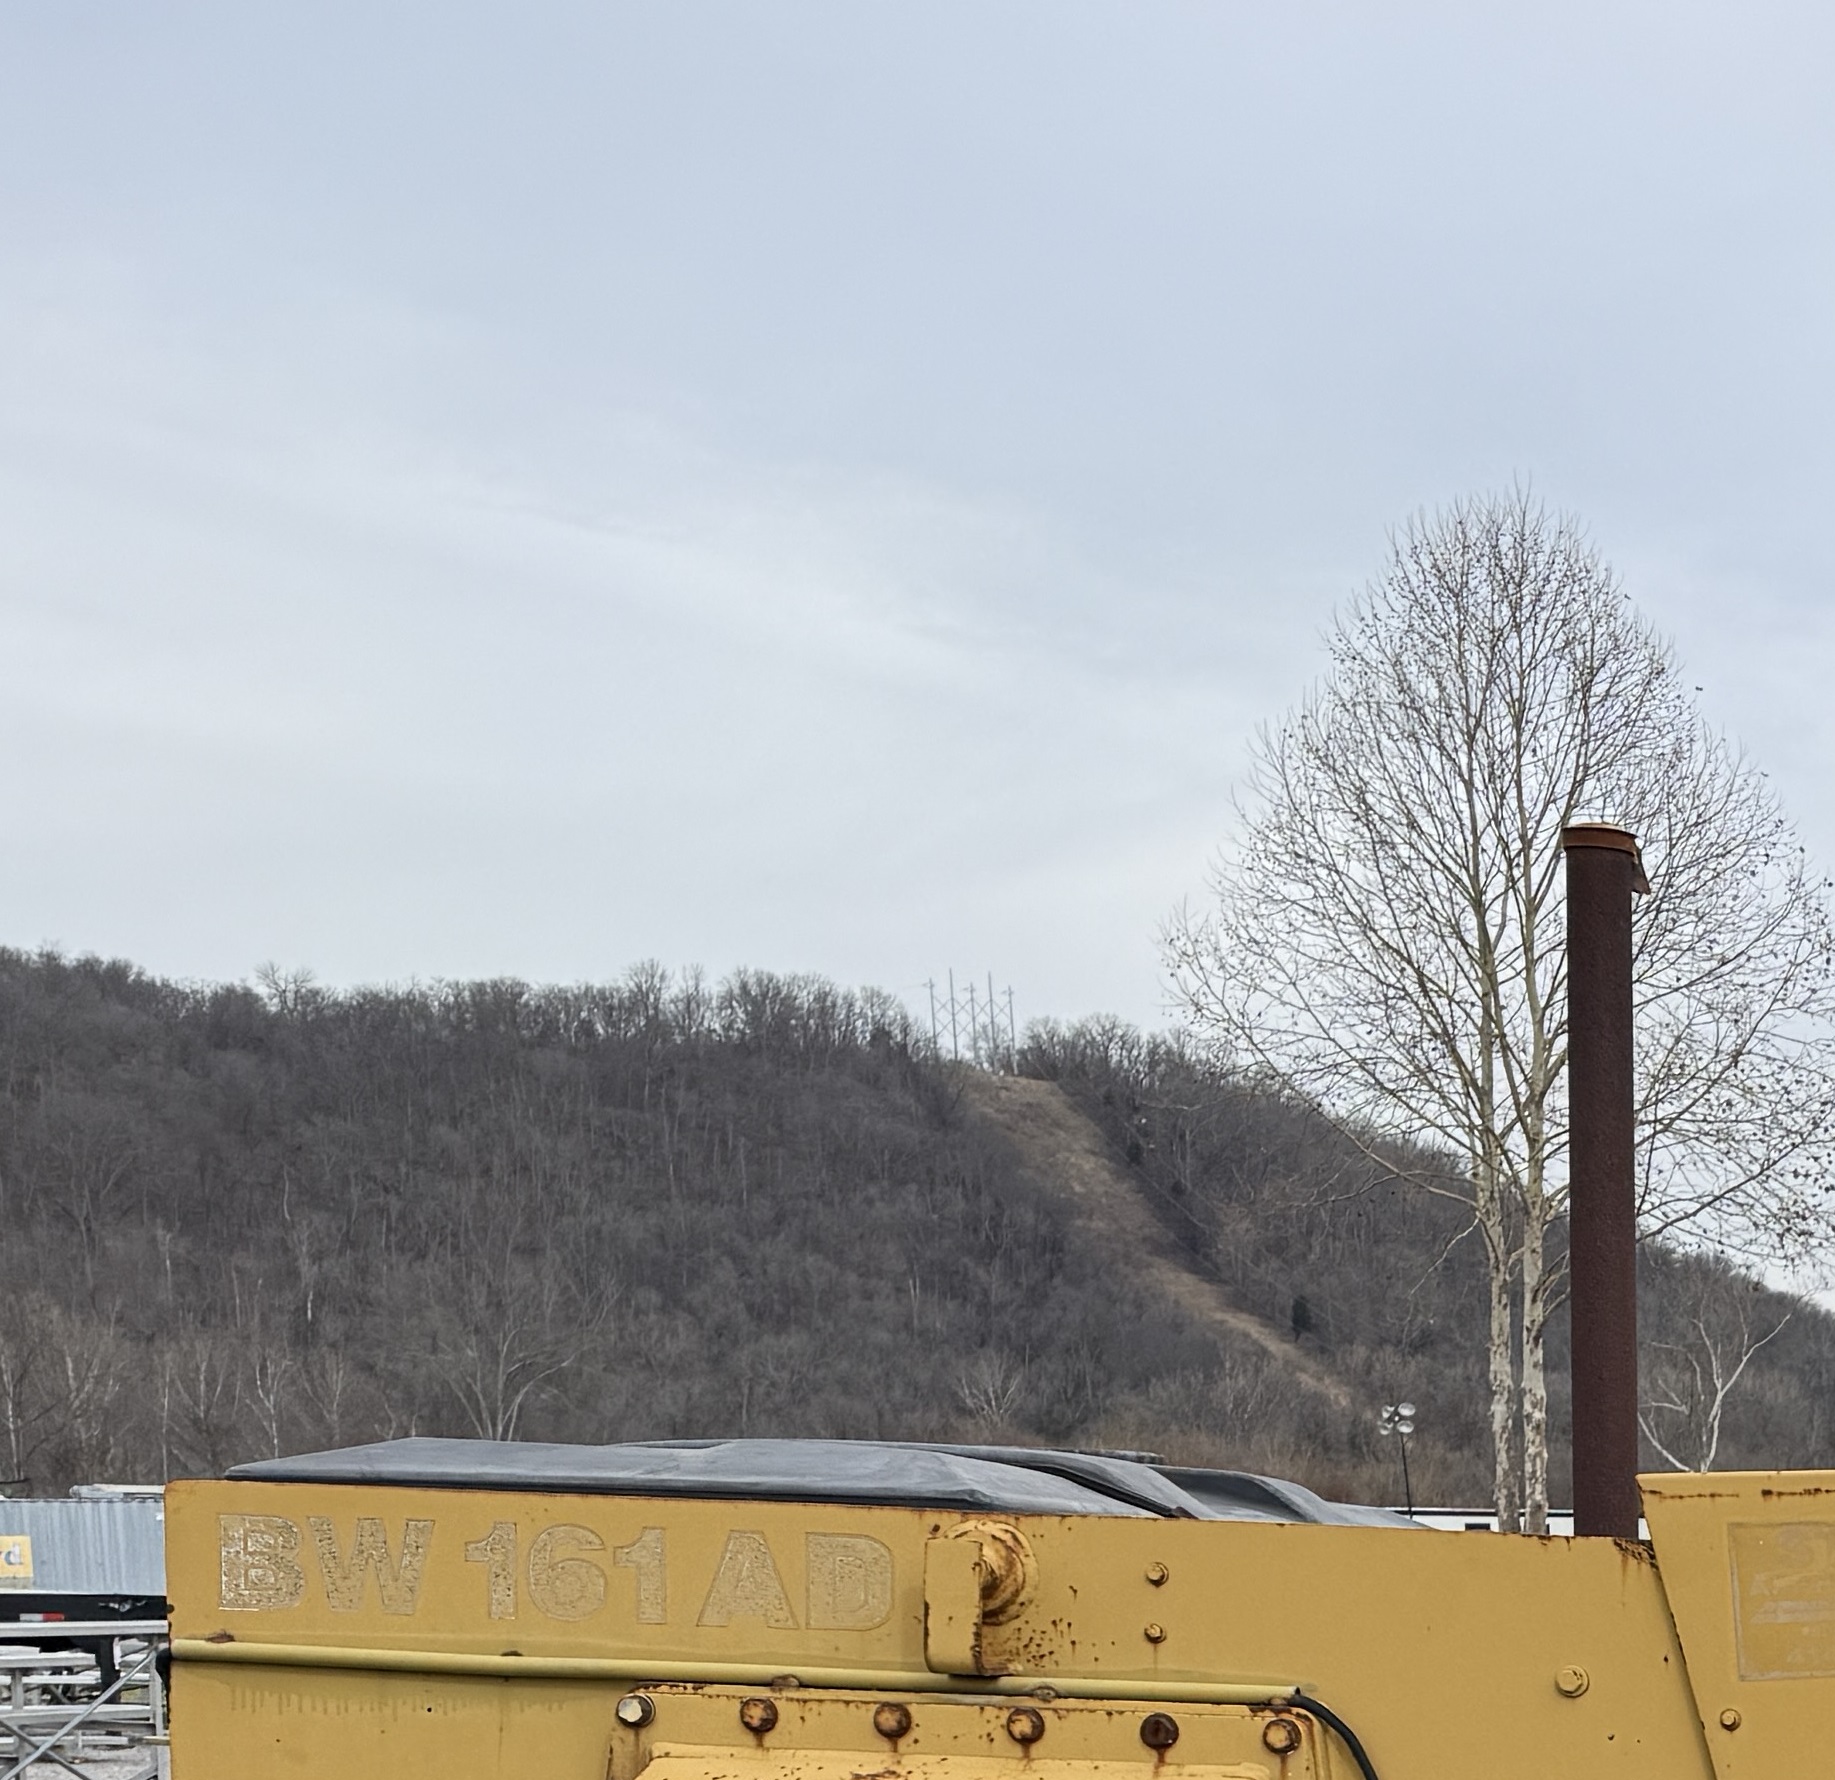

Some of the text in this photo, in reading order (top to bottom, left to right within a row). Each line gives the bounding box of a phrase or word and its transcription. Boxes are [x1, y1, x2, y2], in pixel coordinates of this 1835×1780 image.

[217, 1514, 894, 1631] BW 161 AD
